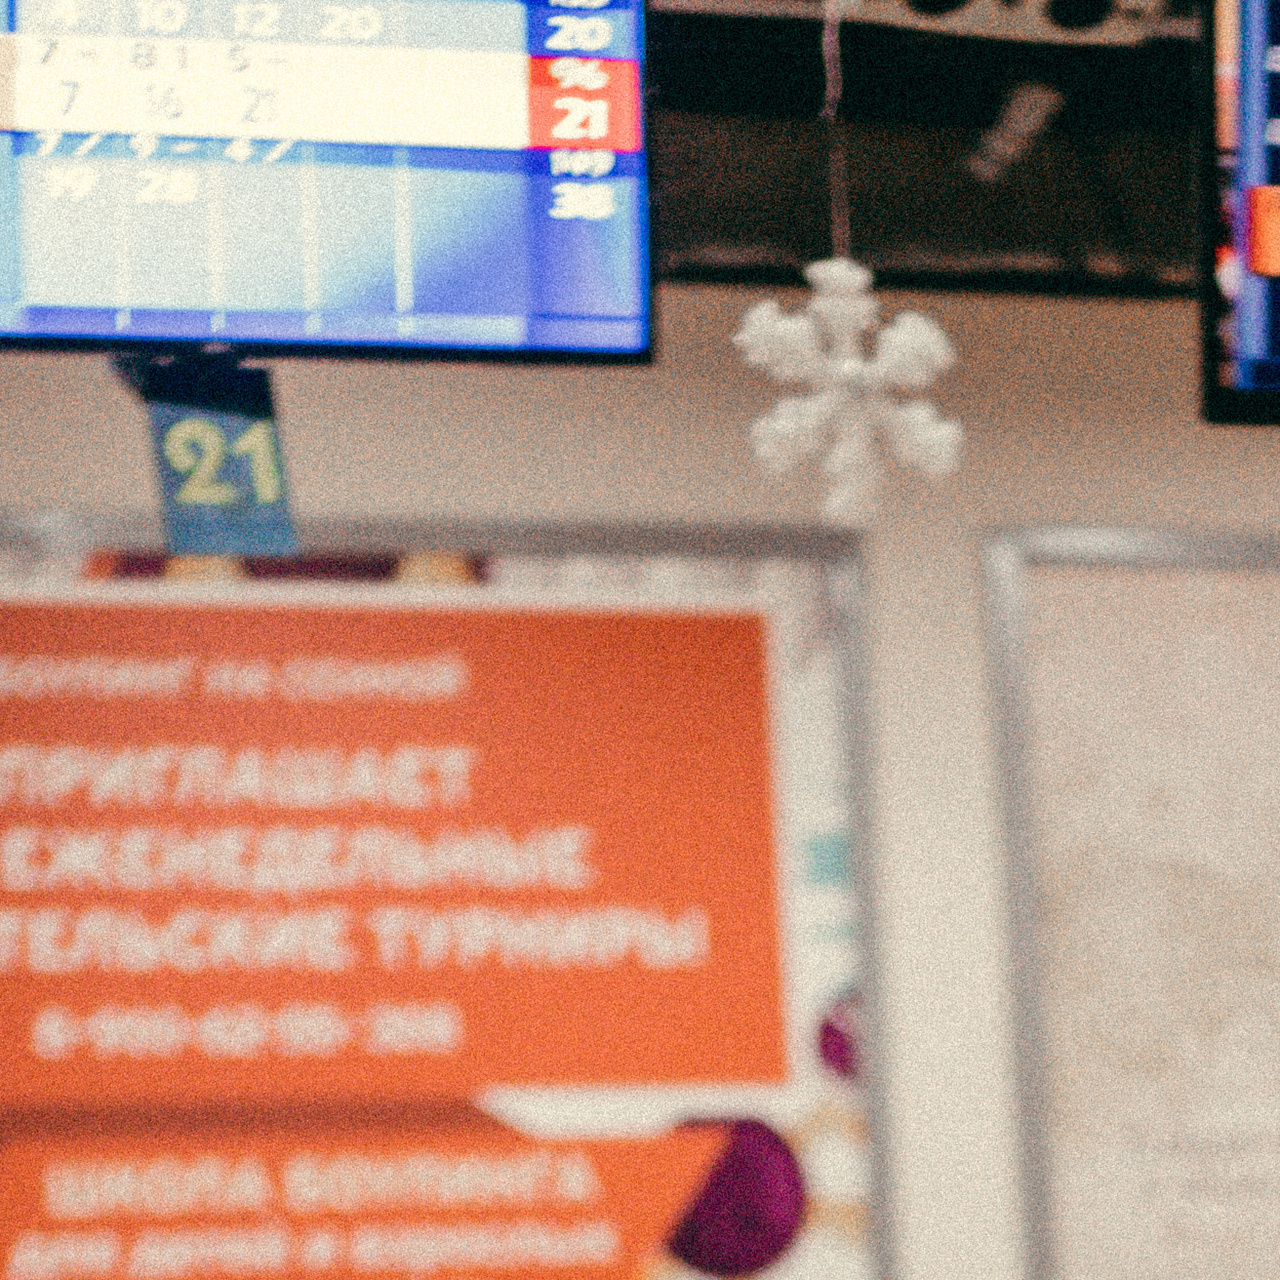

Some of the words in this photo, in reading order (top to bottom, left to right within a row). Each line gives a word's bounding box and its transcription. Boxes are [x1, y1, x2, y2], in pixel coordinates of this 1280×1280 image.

[136, 1, 188, 32] 10
[320, 6, 384, 40] 20
[545, 15, 613, 51] 20
[551, 96, 610, 140] 21
[163, 417, 283, 506] 21
[3, 824, 597, 893] ЕЖЕНЕДЕЛЬНЫЕ
[370, 905, 711, 969] ТУРНИРЫ
